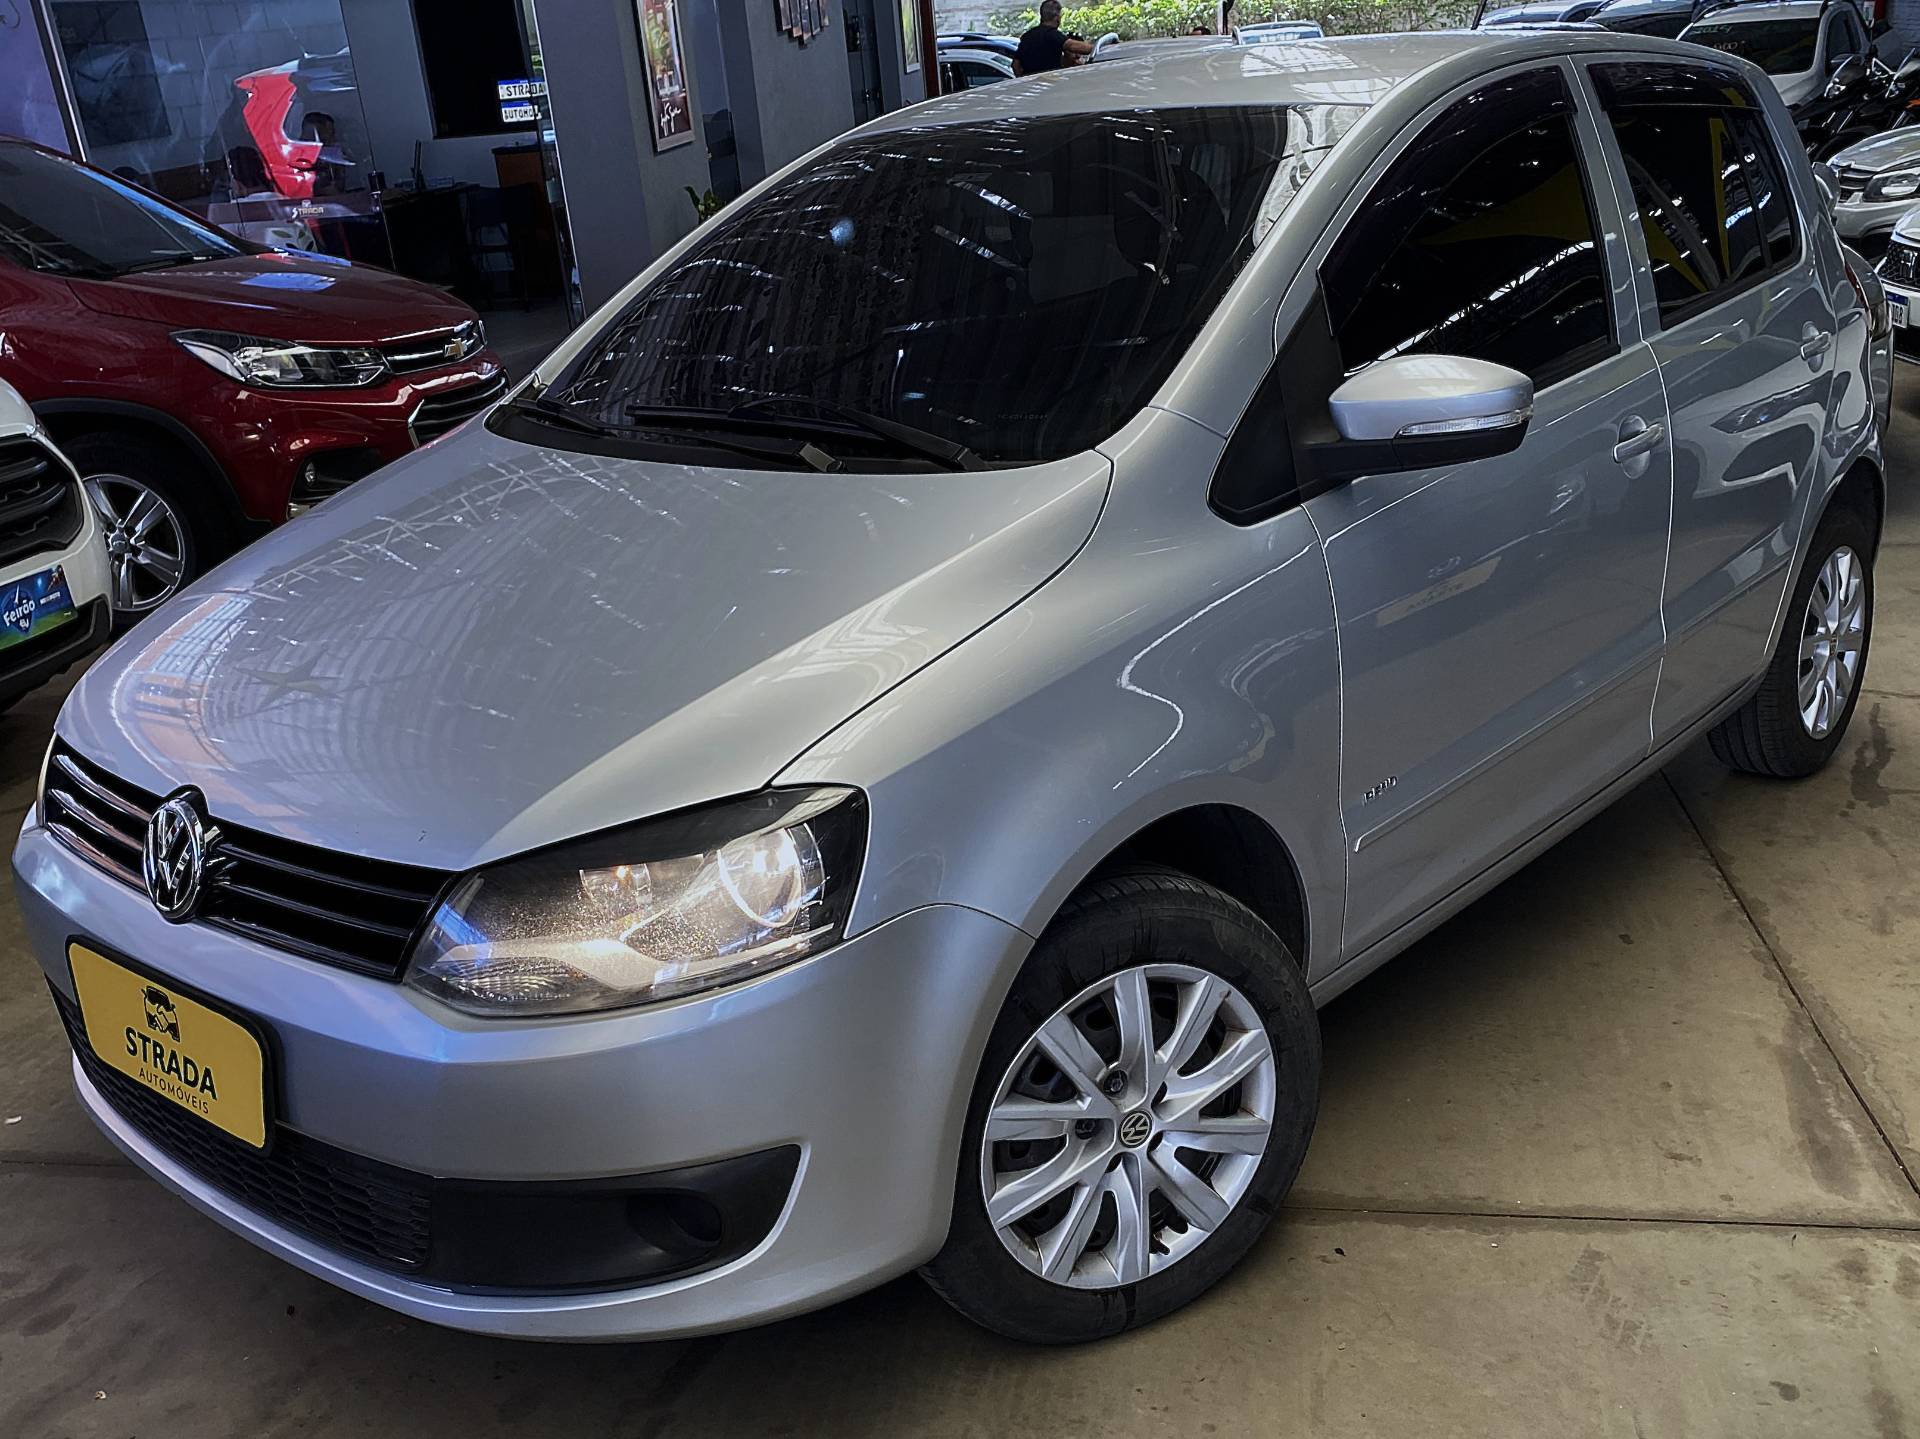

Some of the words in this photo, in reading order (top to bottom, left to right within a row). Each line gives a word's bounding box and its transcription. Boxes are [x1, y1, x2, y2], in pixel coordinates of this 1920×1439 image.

[506, 83, 544, 96] STRADA
[3, 599, 36, 627] Feirão
[125, 1026, 217, 1101] STRADA
[139, 1067, 209, 1114] AUTOMÓVEIS
